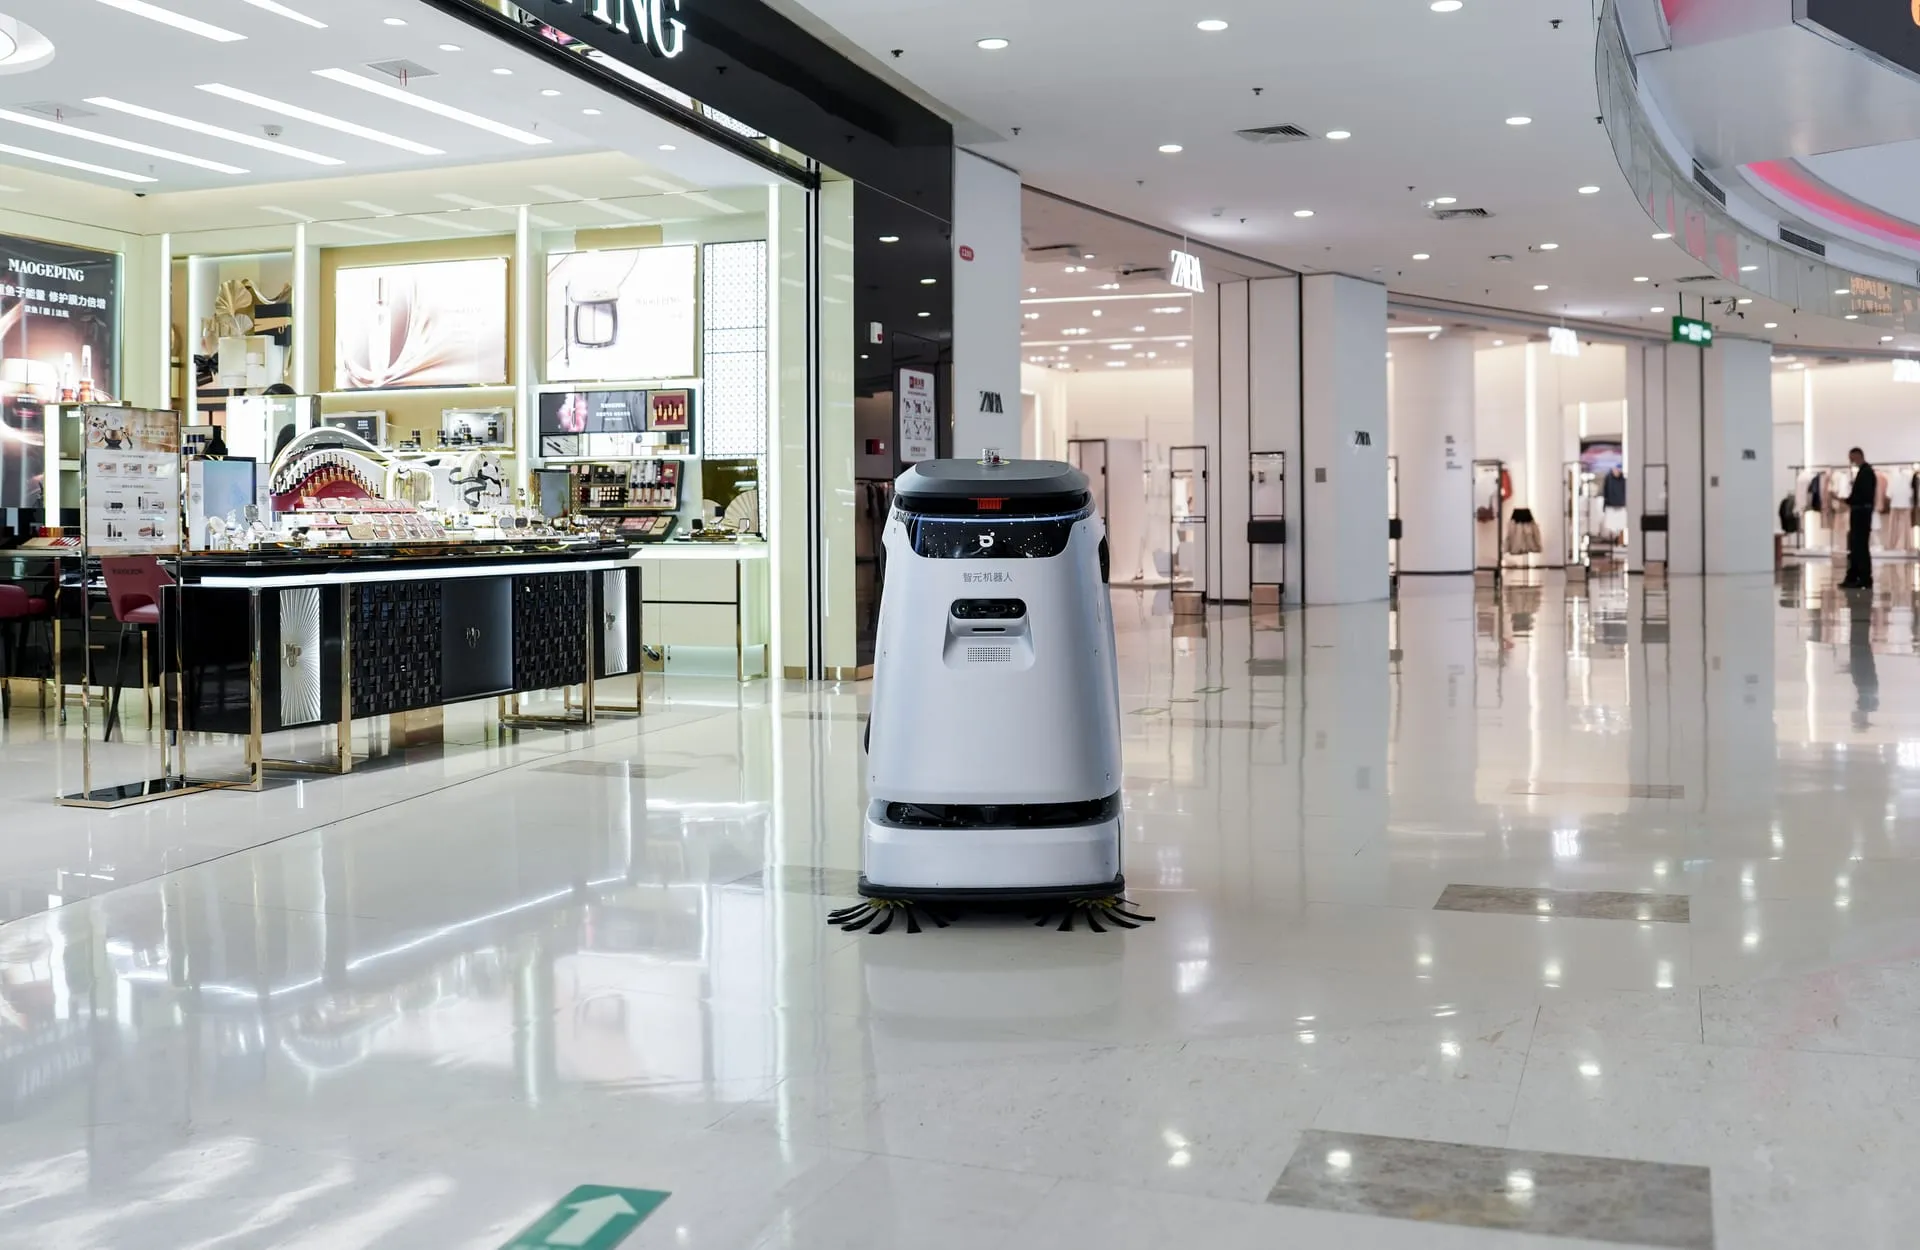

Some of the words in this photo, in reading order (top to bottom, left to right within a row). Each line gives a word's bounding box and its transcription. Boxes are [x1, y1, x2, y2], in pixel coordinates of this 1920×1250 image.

[8, 258, 85, 281] MAOGEPING
[1171, 249, 1205, 293] ZARA
[963, 571, 1013, 583] 智元机器人
